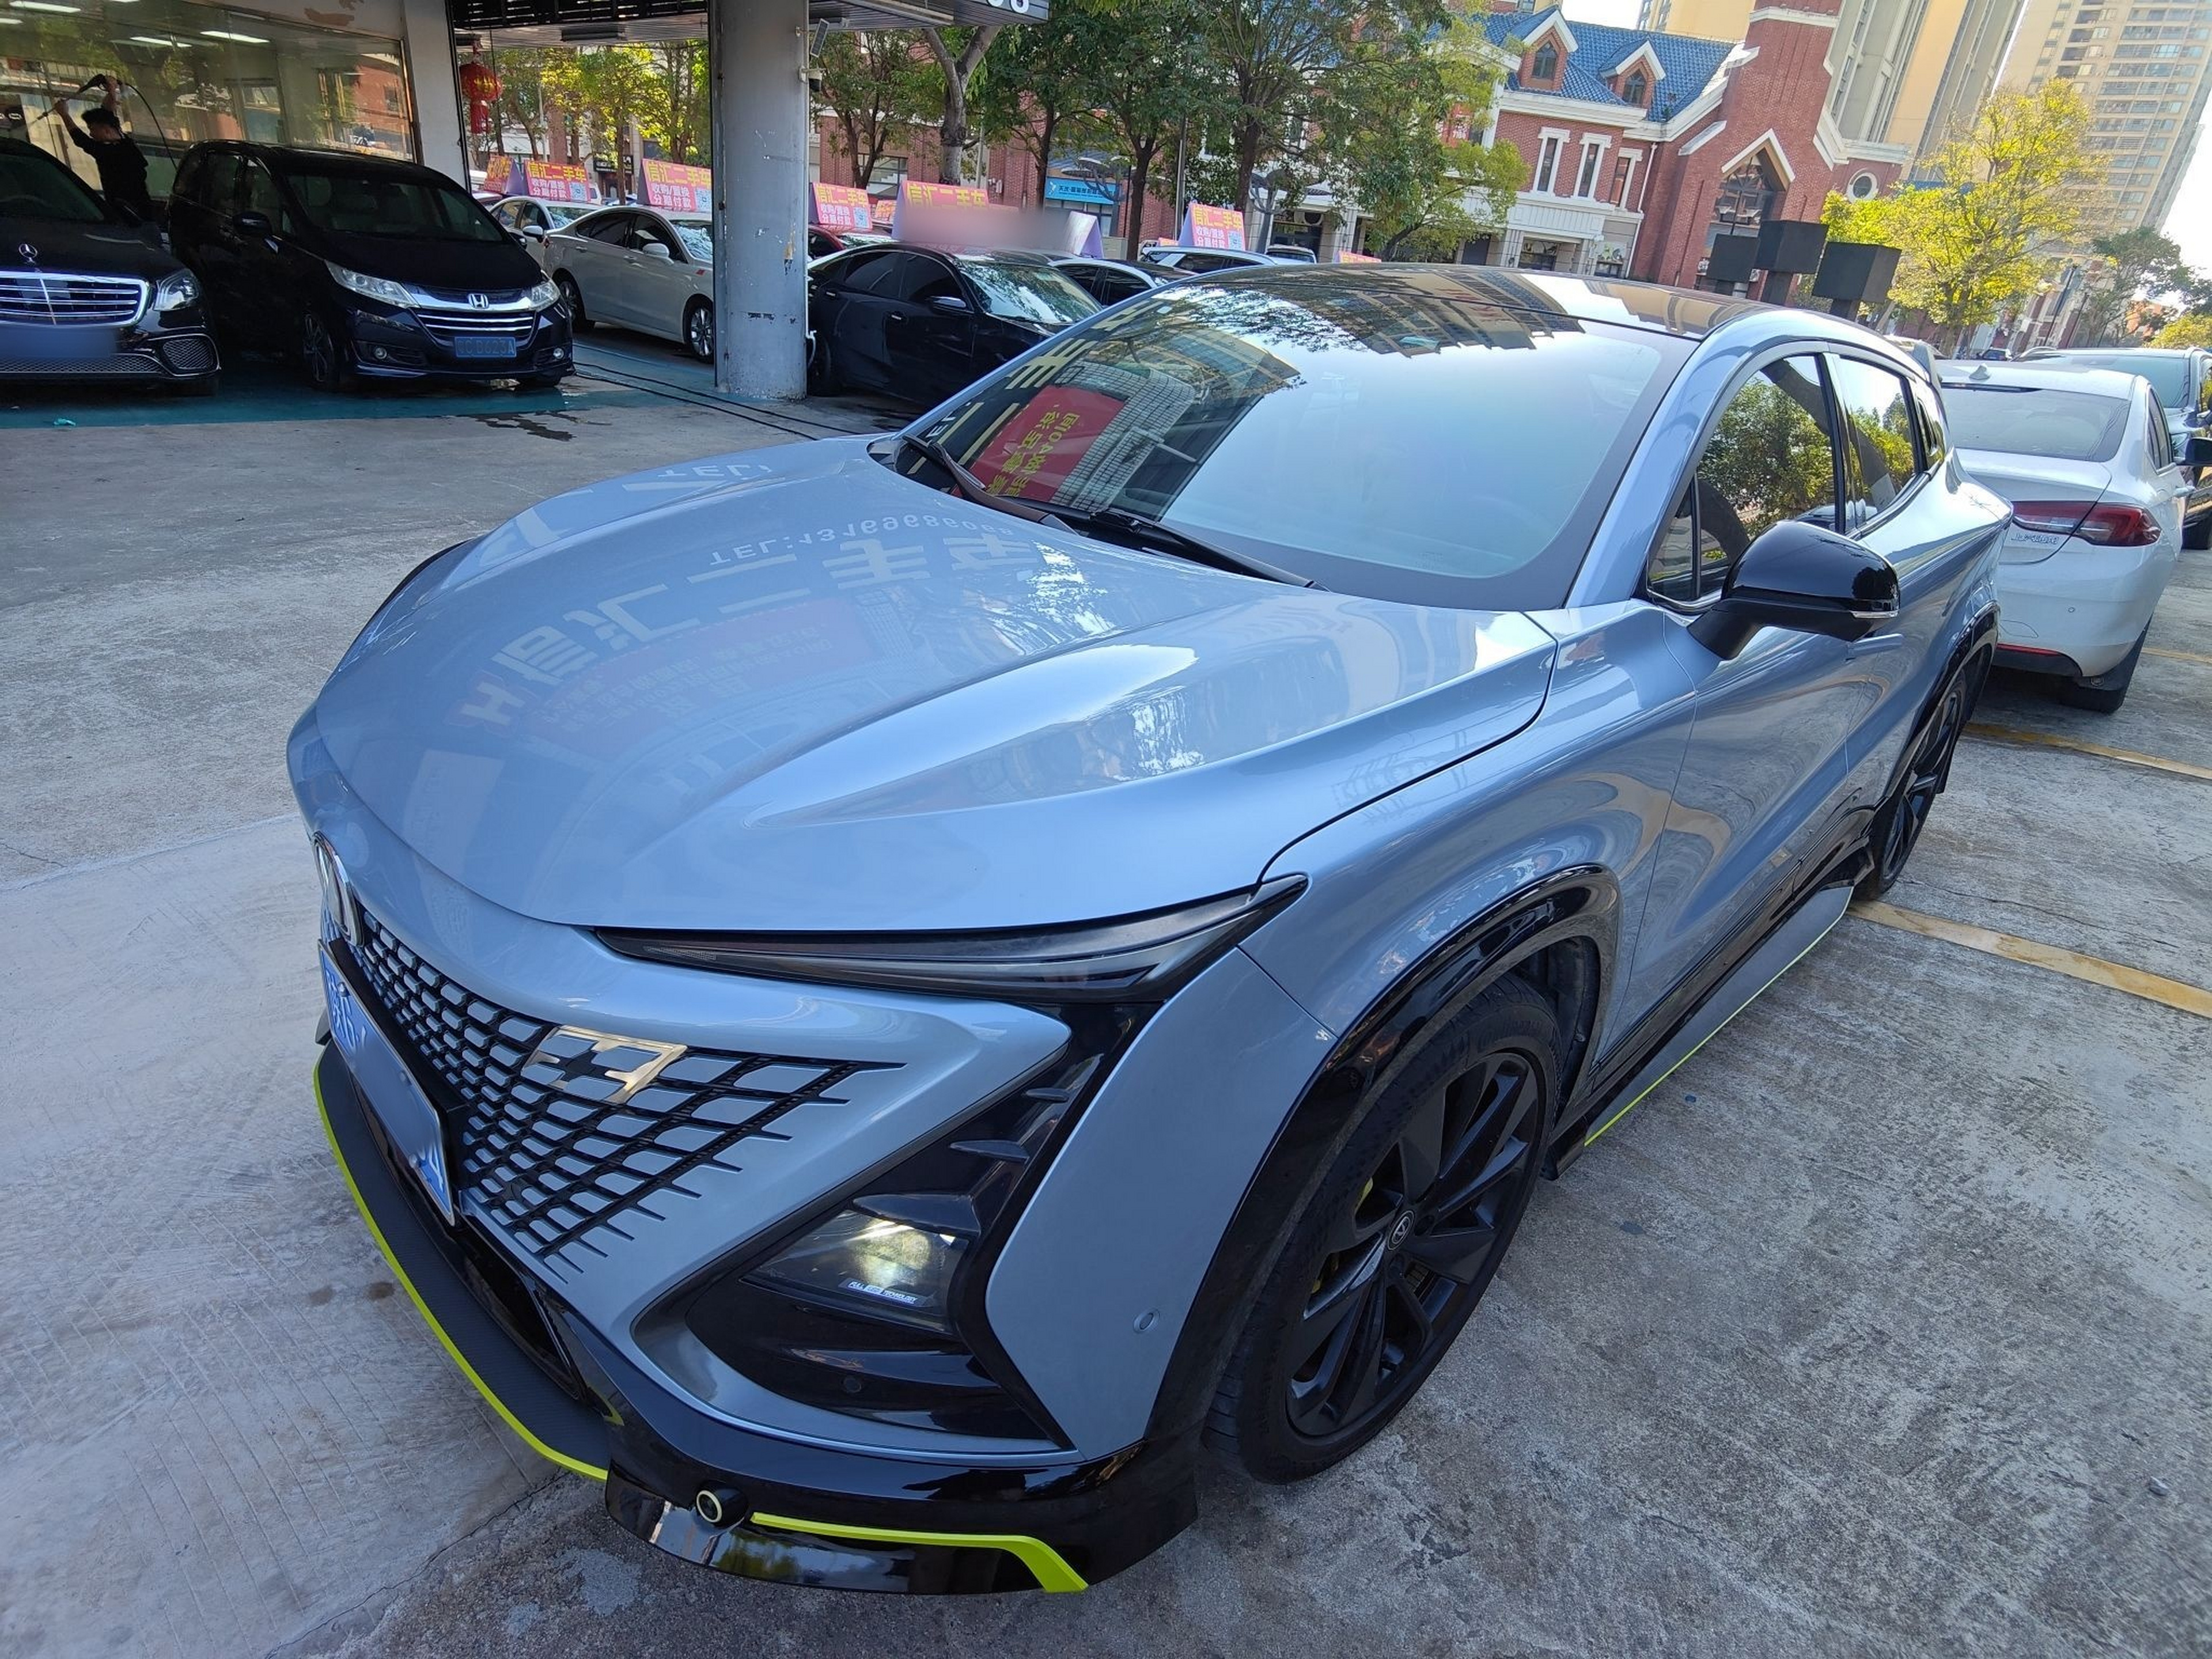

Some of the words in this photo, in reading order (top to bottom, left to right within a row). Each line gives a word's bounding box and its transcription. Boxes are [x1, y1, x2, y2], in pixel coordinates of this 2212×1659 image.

[528, 161, 587, 183] 信汇二手车
[653, 194, 692, 208] 分期付款
[817, 184, 868, 207] 信汇二手车
[1193, 204, 1243, 230] 信汇二手车
